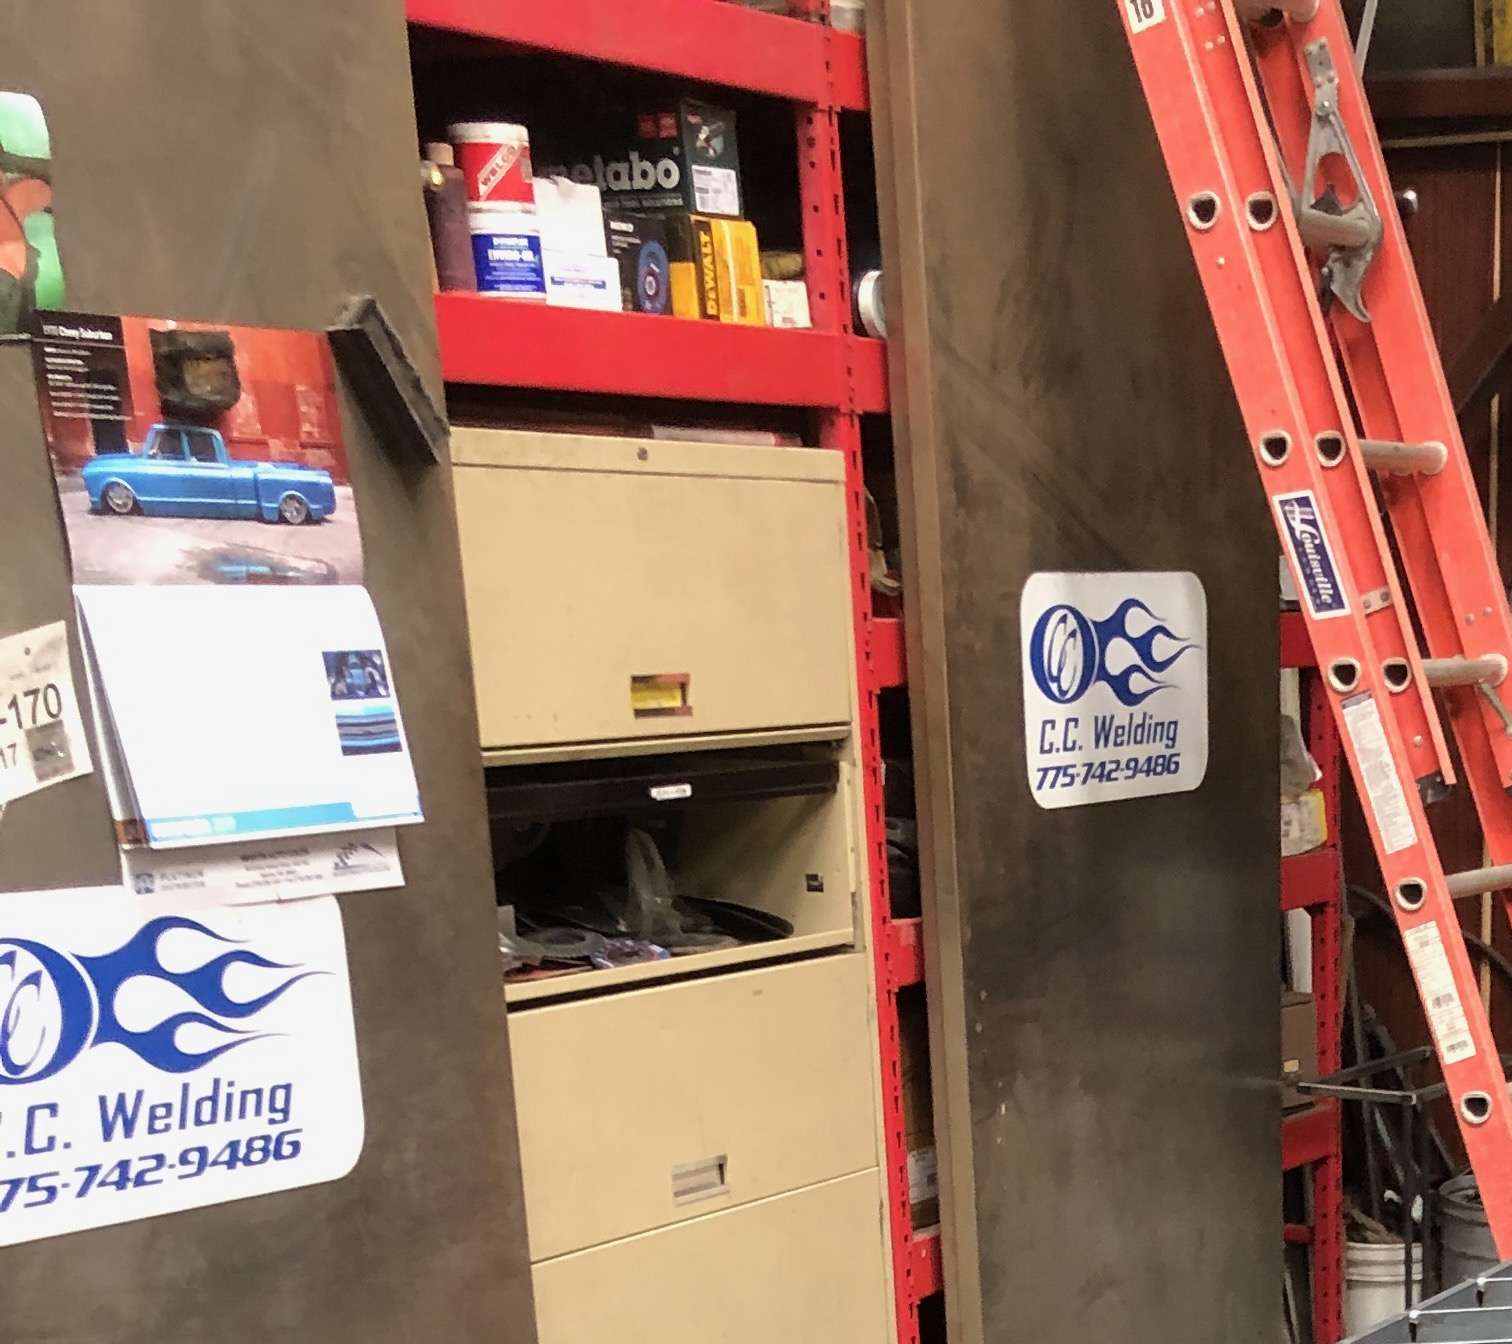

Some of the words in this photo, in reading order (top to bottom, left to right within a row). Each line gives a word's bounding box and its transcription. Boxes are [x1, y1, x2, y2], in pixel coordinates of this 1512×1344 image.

[1284, 500, 1333, 604] Louisville
[1039, 717, 1084, 755] C.C.
[1094, 711, 1179, 750] Welding
[1035, 752, 1182, 792] 775-742-9486
[0, 1101, 72, 1159] .C.
[98, 1076, 293, 1143] Welding
